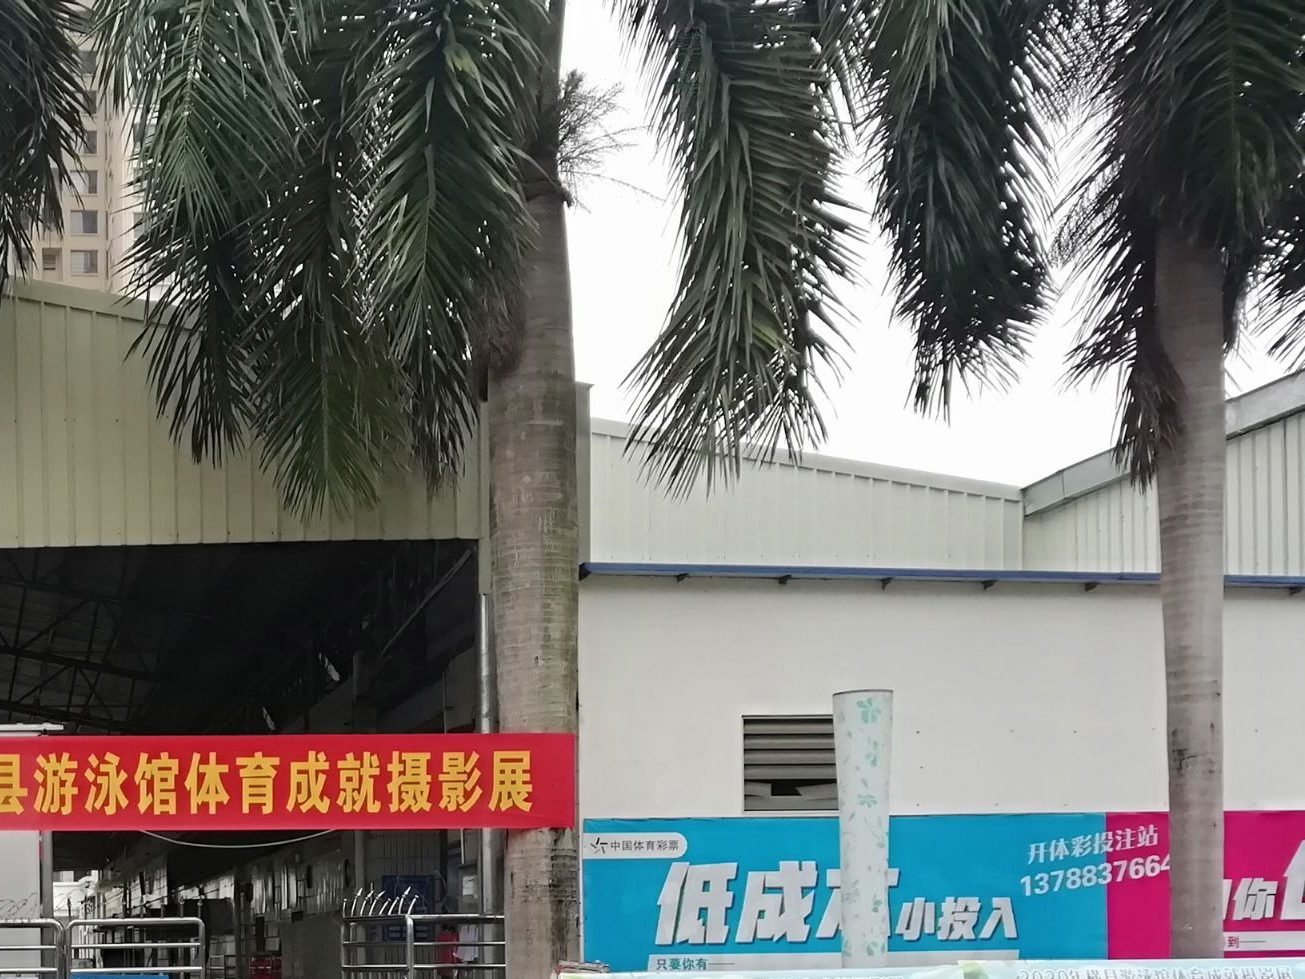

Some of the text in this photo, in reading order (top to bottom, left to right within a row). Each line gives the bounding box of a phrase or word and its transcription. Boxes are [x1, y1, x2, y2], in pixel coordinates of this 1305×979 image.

[610, 839, 679, 852] 中国体育彩票
[1027, 824, 1159, 865] 开体彩投注站
[896, 896, 1018, 941] 小投入
